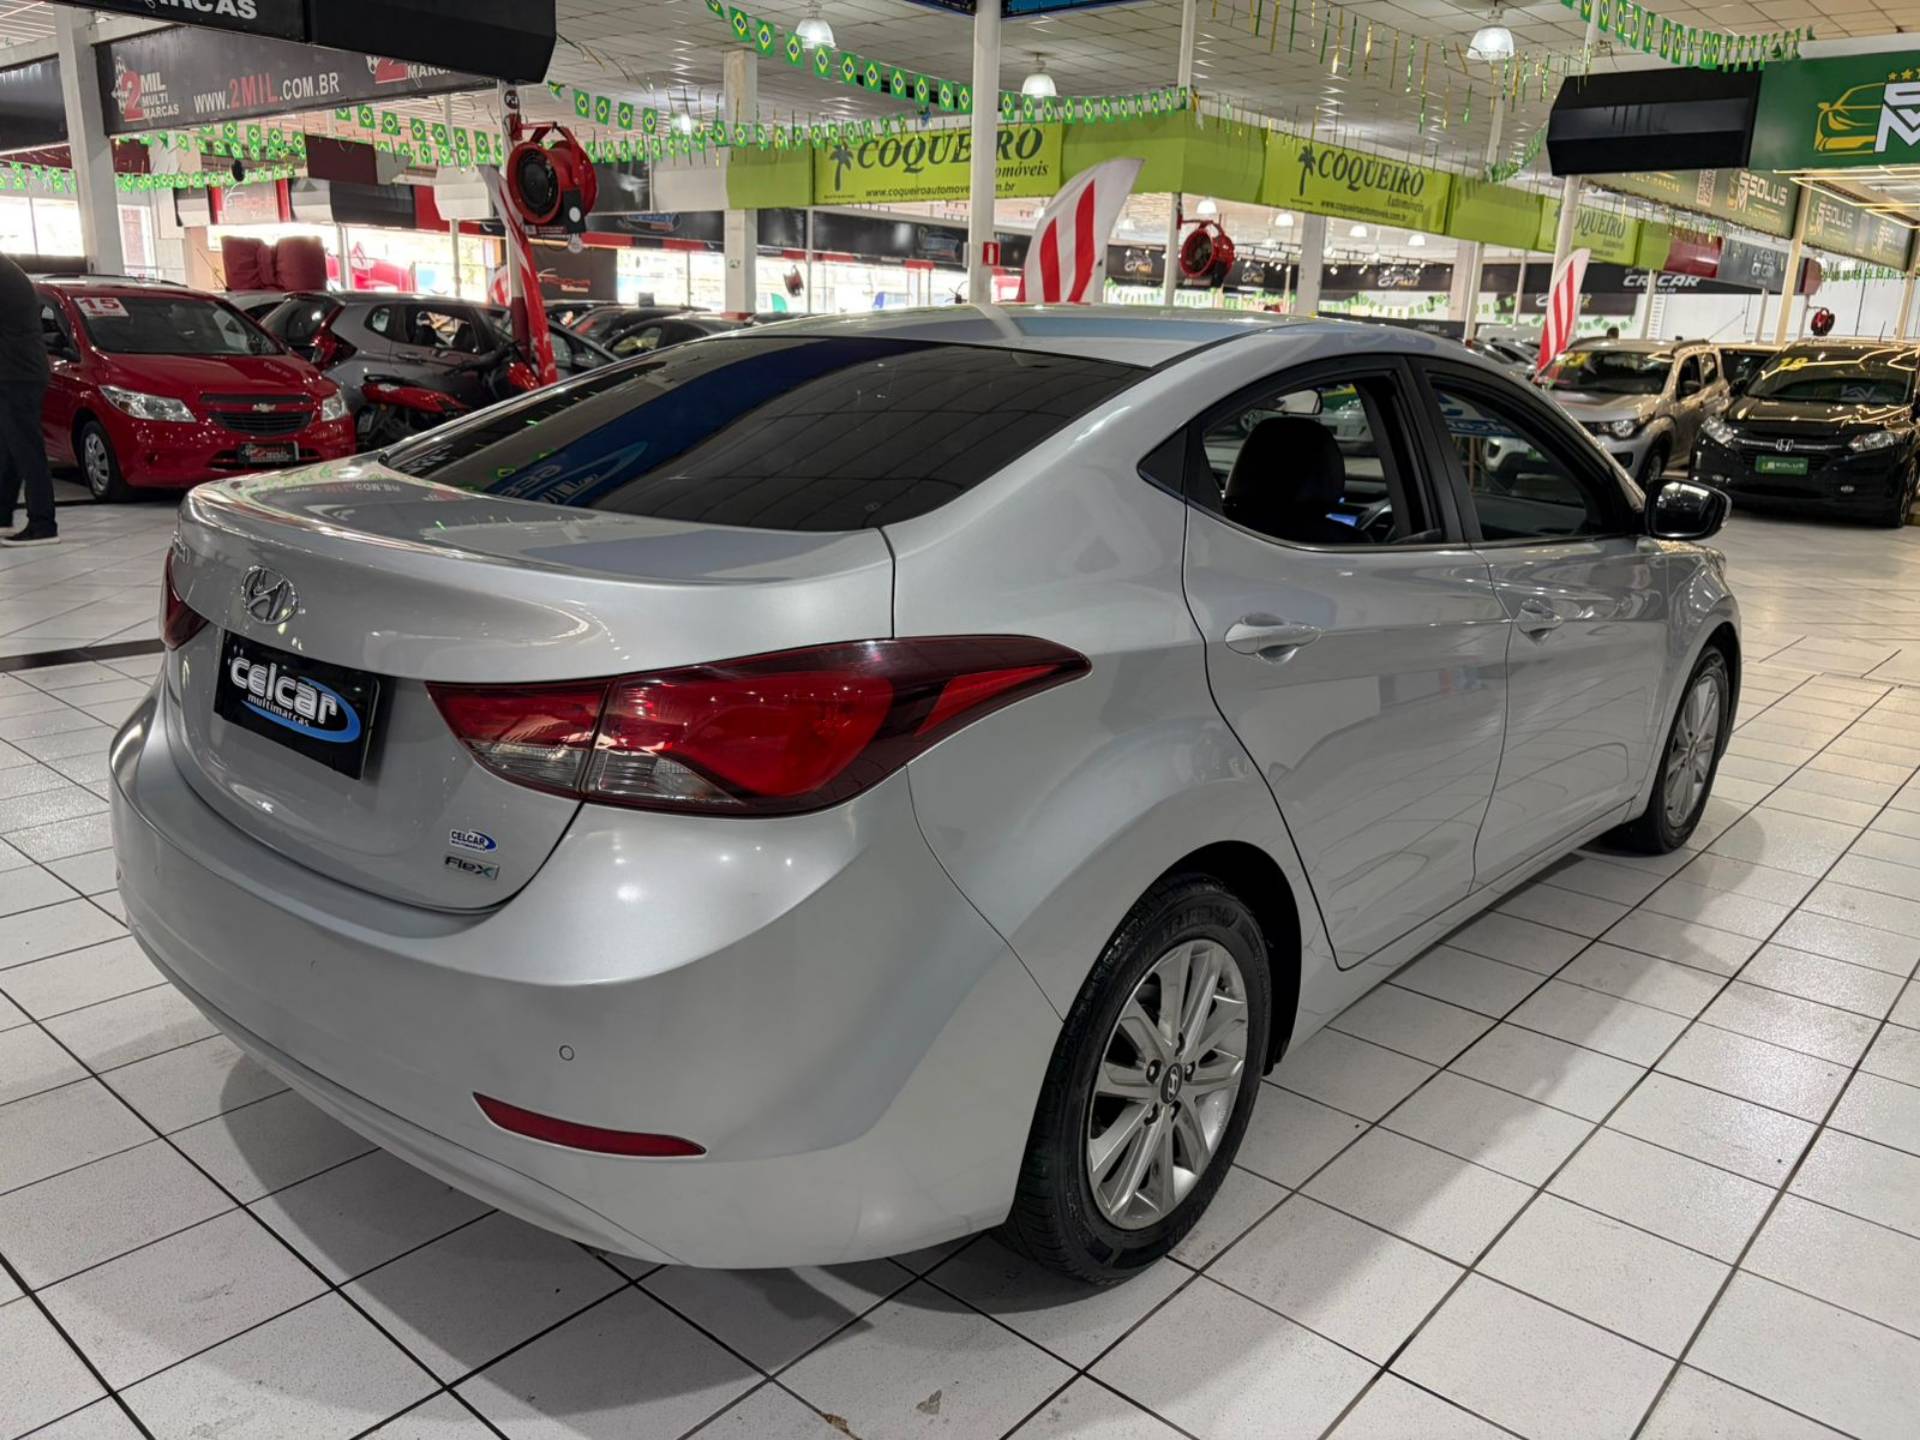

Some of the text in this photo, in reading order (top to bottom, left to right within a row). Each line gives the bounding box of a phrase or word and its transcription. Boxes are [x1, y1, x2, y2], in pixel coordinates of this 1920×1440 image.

[141, 72, 166, 93] MIL
[142, 93, 169, 106] MULTI
[857, 126, 1043, 174] COQUERO
[1318, 150, 1425, 197] COQUEIRO
[1749, 174, 1788, 206] SOLUS
[230, 656, 338, 724] celcar
[247, 694, 310, 727] multimarcas
[451, 831, 486, 847] CELCAR
